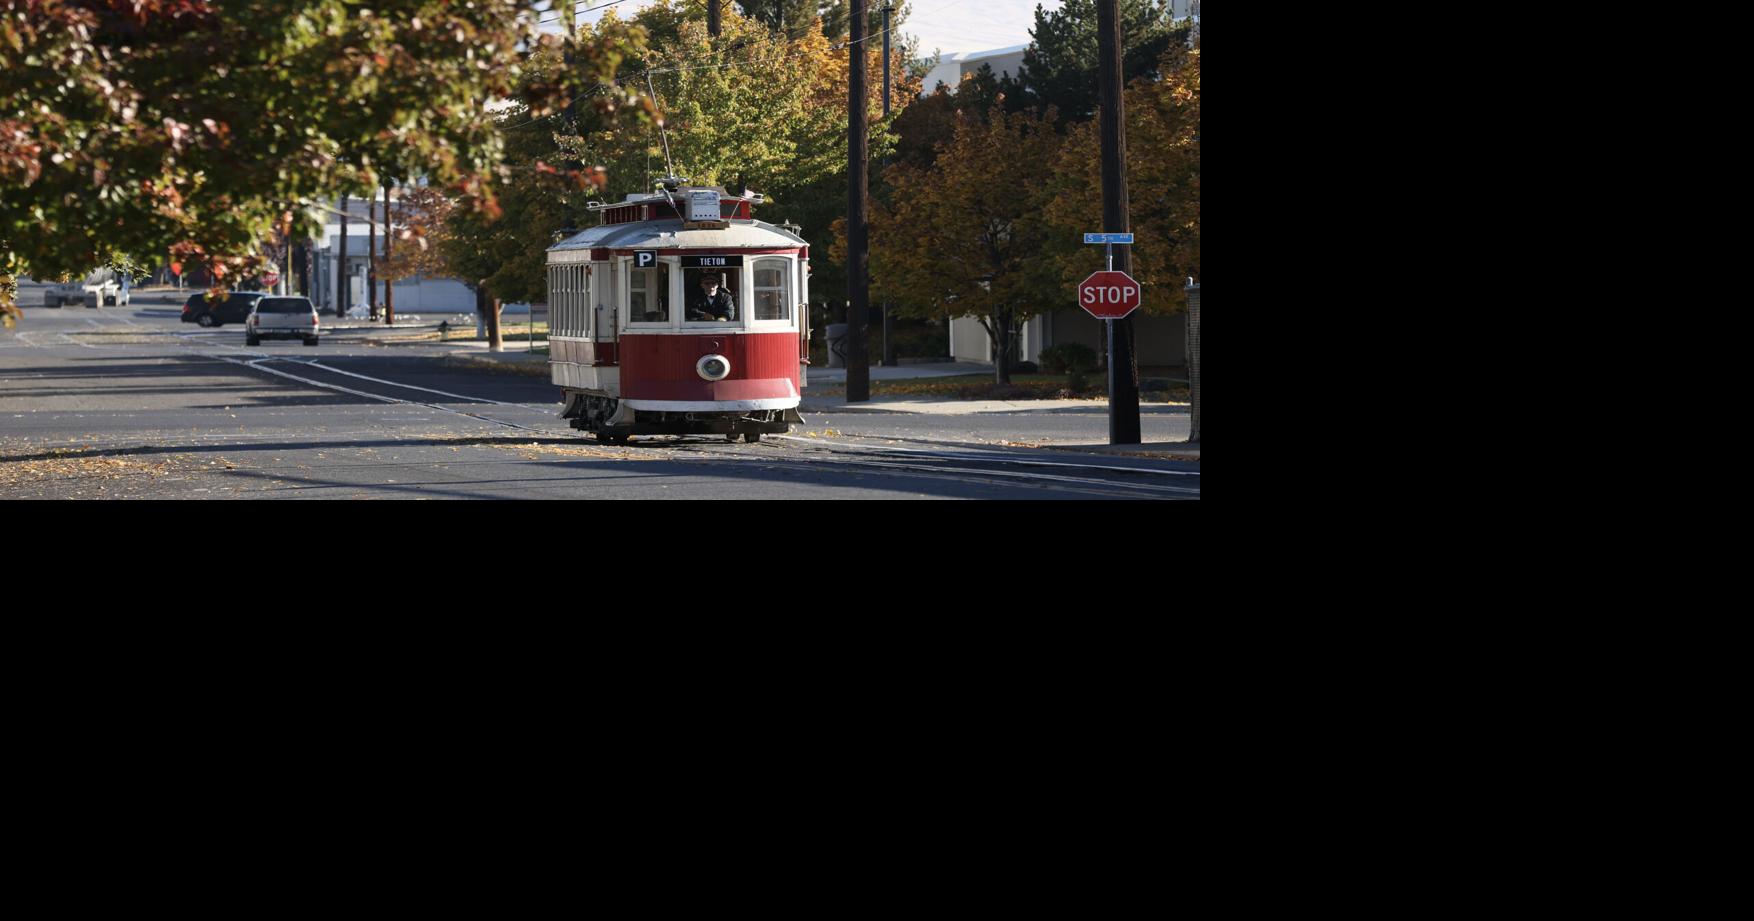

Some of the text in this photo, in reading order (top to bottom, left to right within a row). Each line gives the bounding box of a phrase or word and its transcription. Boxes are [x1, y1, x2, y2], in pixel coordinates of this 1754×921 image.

[1088, 234, 1094, 242] S
[639, 252, 652, 267] P
[700, 257, 726, 266] TIETON
[1083, 286, 1136, 304] STOP
